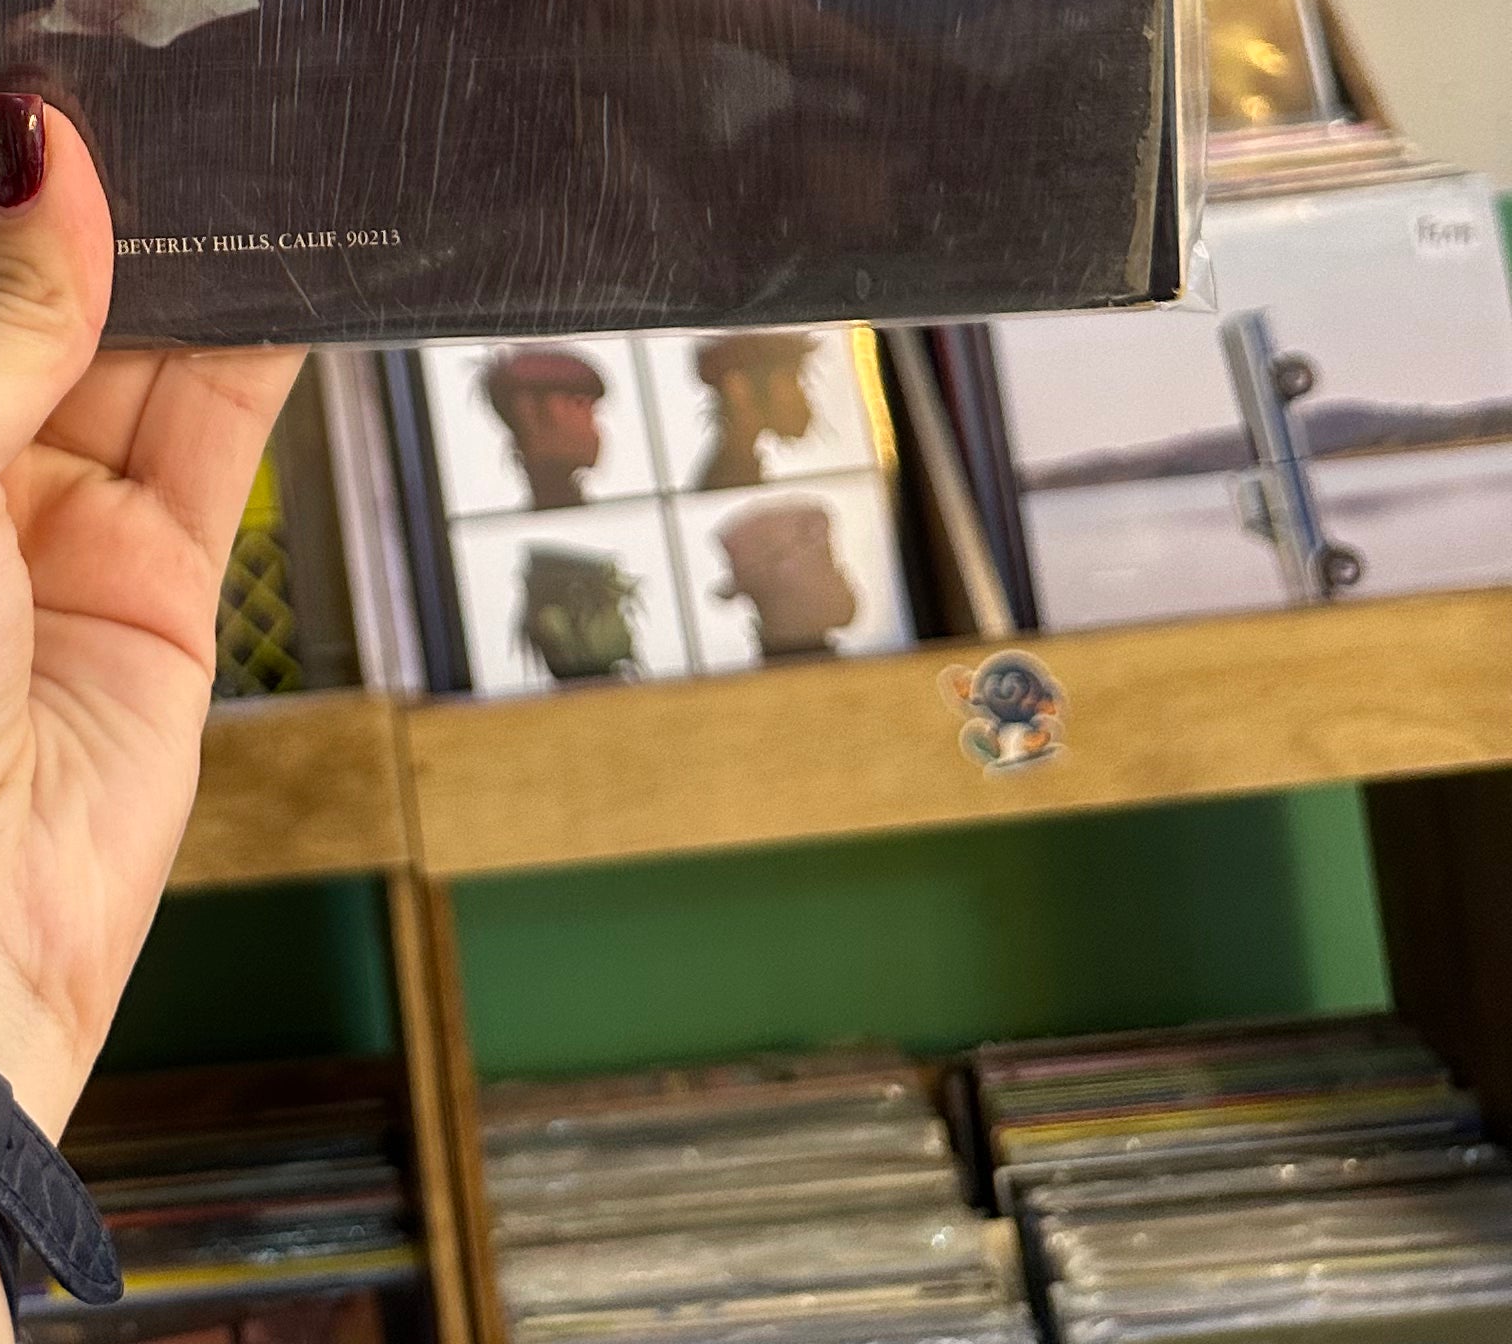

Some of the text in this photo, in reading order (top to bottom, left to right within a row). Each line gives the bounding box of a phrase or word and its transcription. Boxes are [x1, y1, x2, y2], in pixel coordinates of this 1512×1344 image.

[115, 229, 401, 255] BEVERLY HILLS, CALIF. 90213
